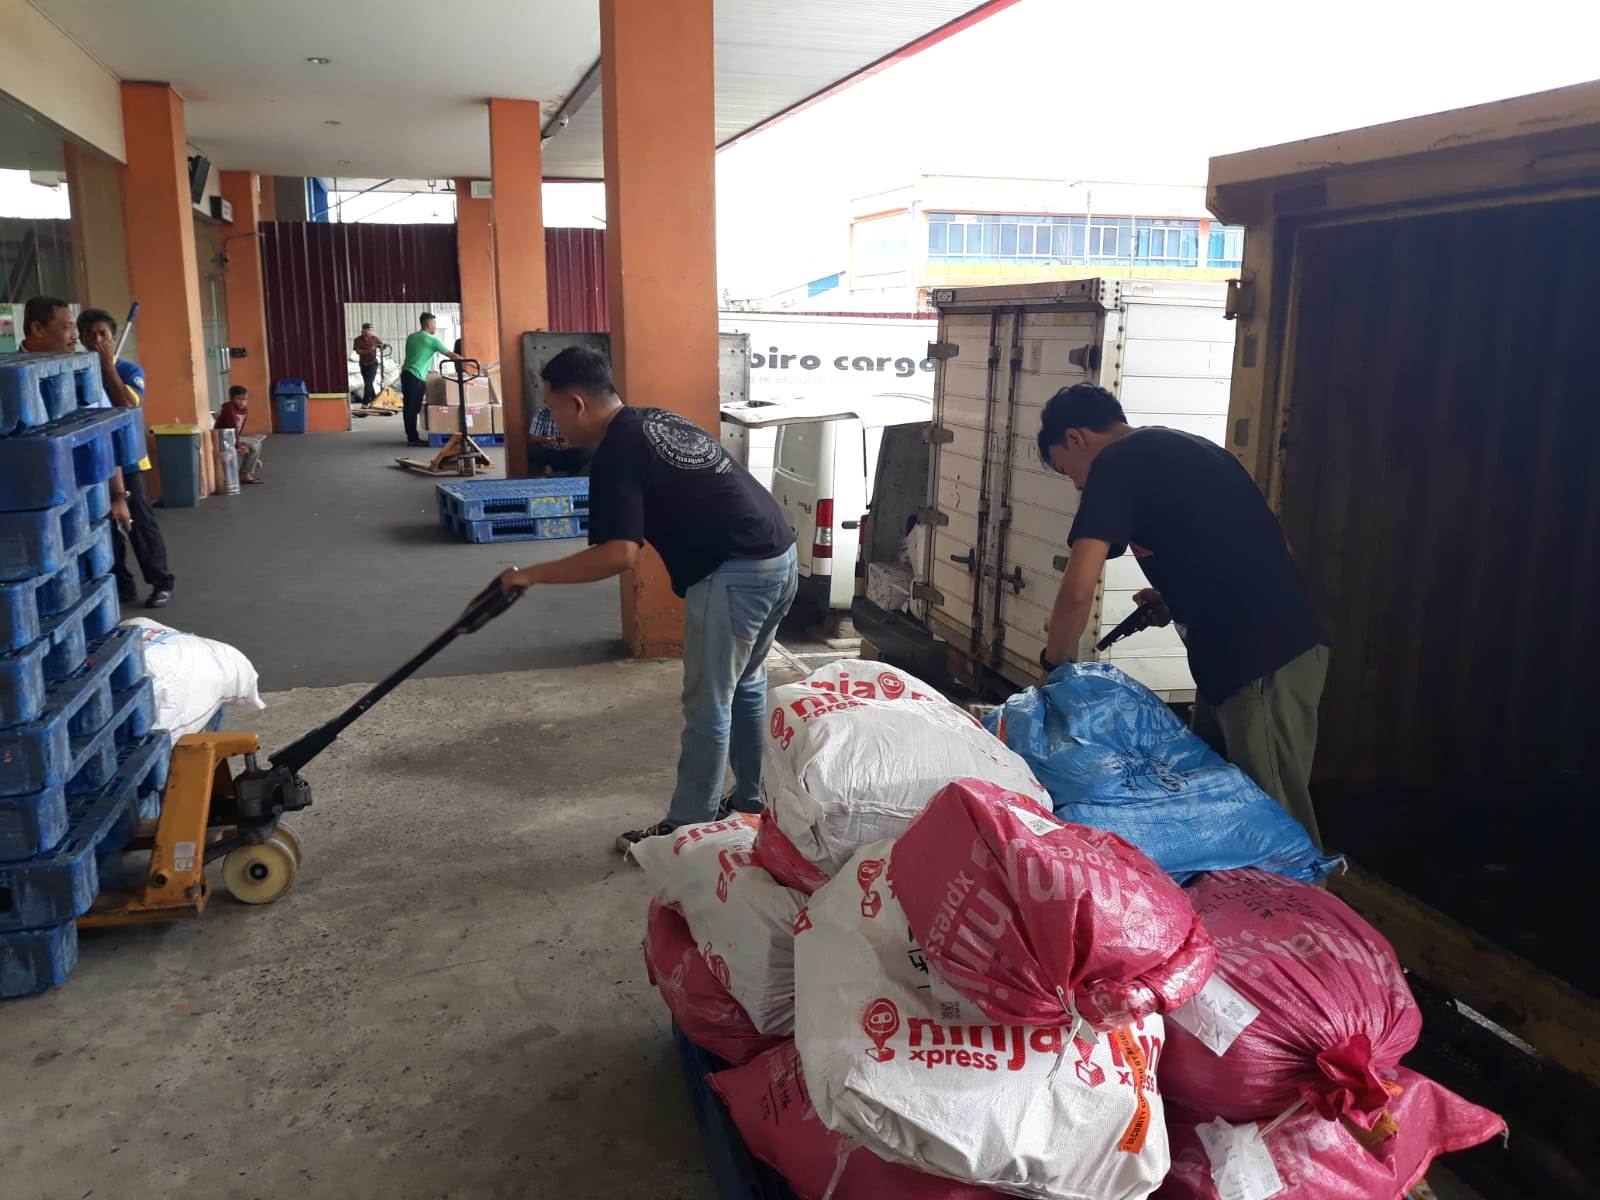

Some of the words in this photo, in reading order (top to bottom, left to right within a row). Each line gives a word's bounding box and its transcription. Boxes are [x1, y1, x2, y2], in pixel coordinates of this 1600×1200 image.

[833, 355, 937, 378] cargo
[907, 1017, 1062, 1071] ninja
[908, 1049, 998, 1072] xpress
[1125, 1111, 1147, 1146] SECURITY
